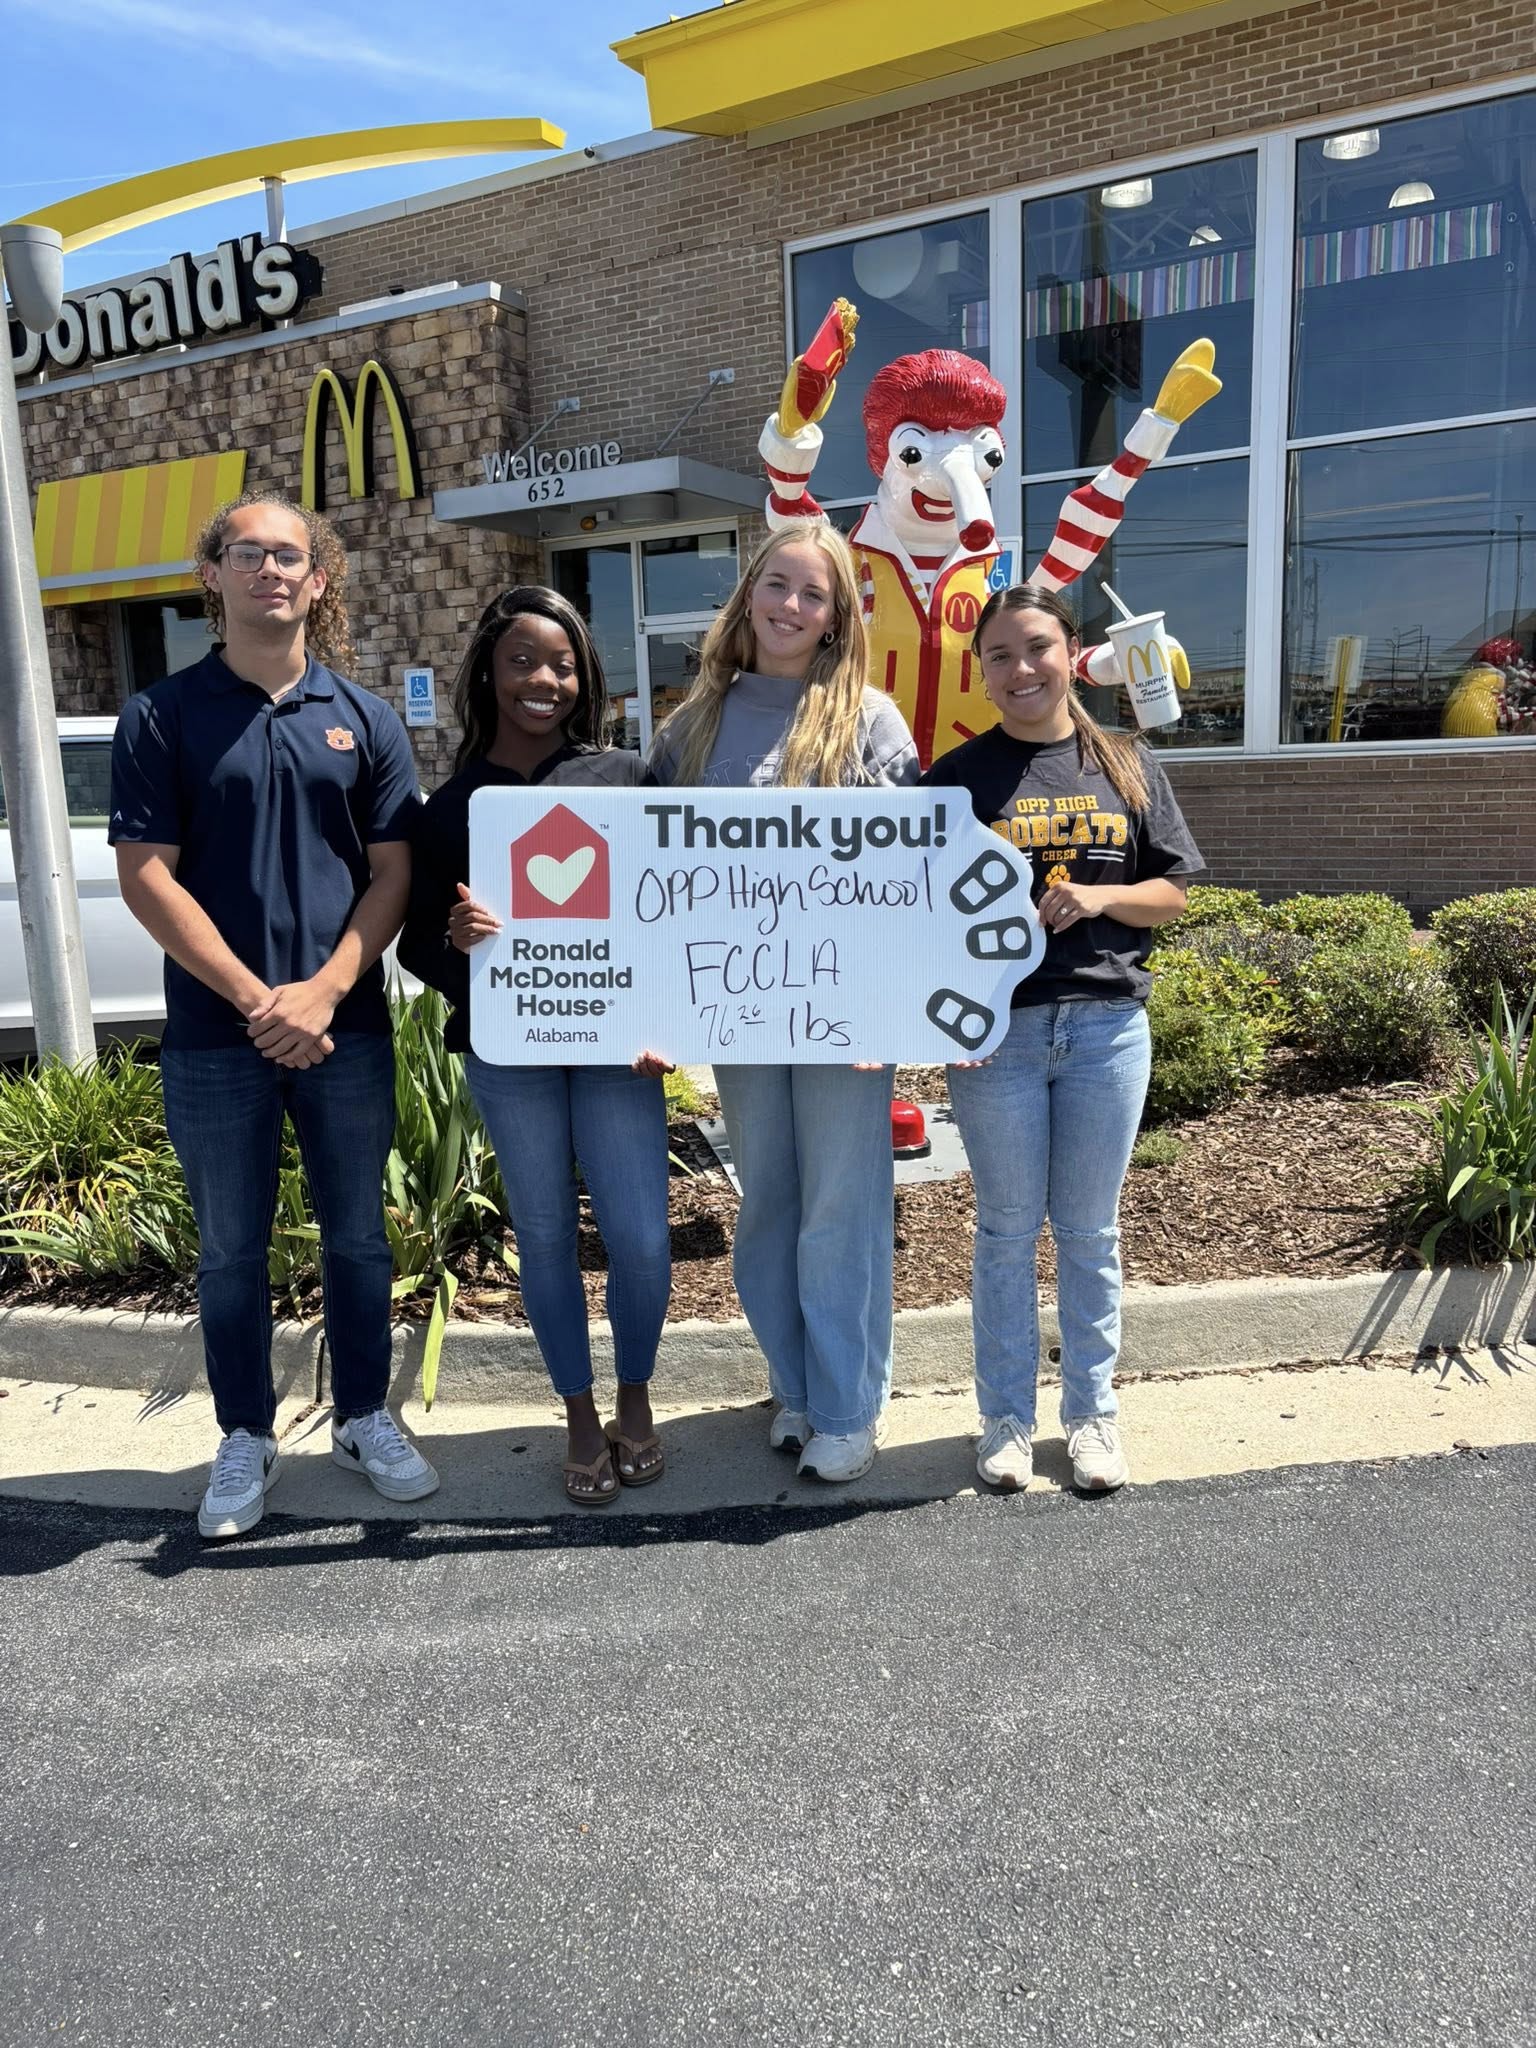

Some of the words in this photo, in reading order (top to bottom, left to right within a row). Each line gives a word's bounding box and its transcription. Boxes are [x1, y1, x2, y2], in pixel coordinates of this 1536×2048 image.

[482, 440, 622, 484] Welcome
[528, 477, 565, 502] 652
[1135, 674, 1168, 689] MURPHY
[1016, 798, 1050, 813] OPP
[1054, 795, 1099, 812] HIGH
[644, 804, 822, 848] Thank
[830, 803, 947, 862] you!
[1042, 849, 1077, 862] CHEER
[726, 864, 808, 936] High
[808, 856, 933, 913] School
[512, 938, 610, 961] Ronald
[490, 966, 633, 989] McDonald
[685, 938, 841, 1005] FCCLA
[525, 1028, 599, 1043] Alabama
